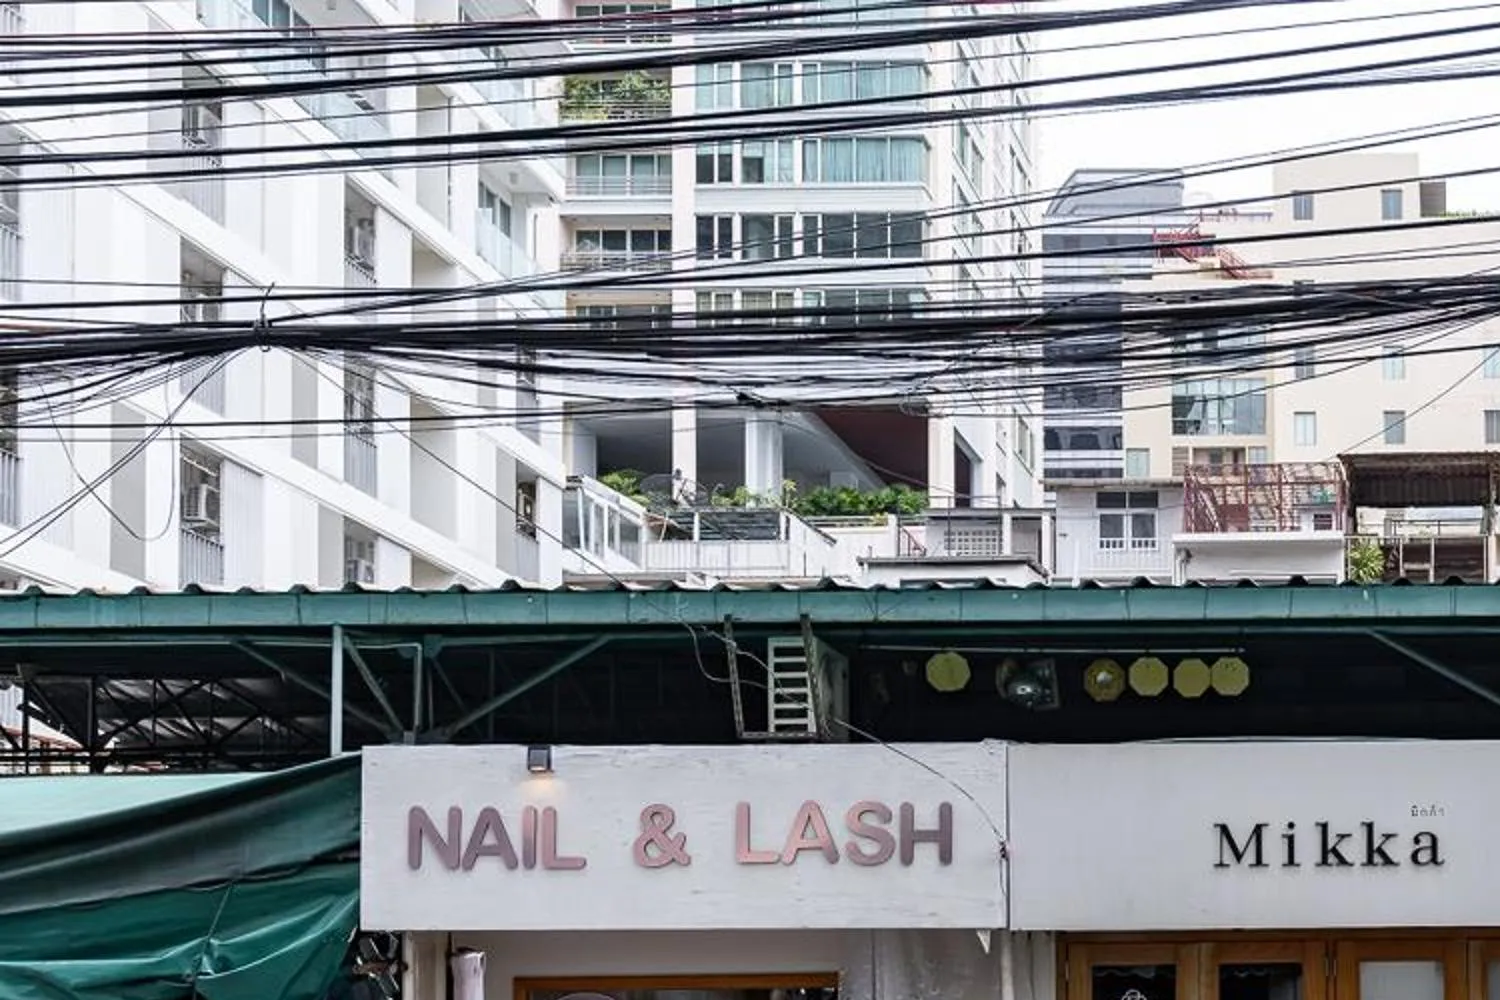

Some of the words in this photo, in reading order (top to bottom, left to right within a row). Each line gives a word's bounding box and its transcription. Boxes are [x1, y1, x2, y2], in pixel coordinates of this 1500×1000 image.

[407, 805, 588, 871] NAIL
[632, 803, 692, 868] &
[735, 799, 954, 867] LASH
[1213, 821, 1446, 868] Mikka
